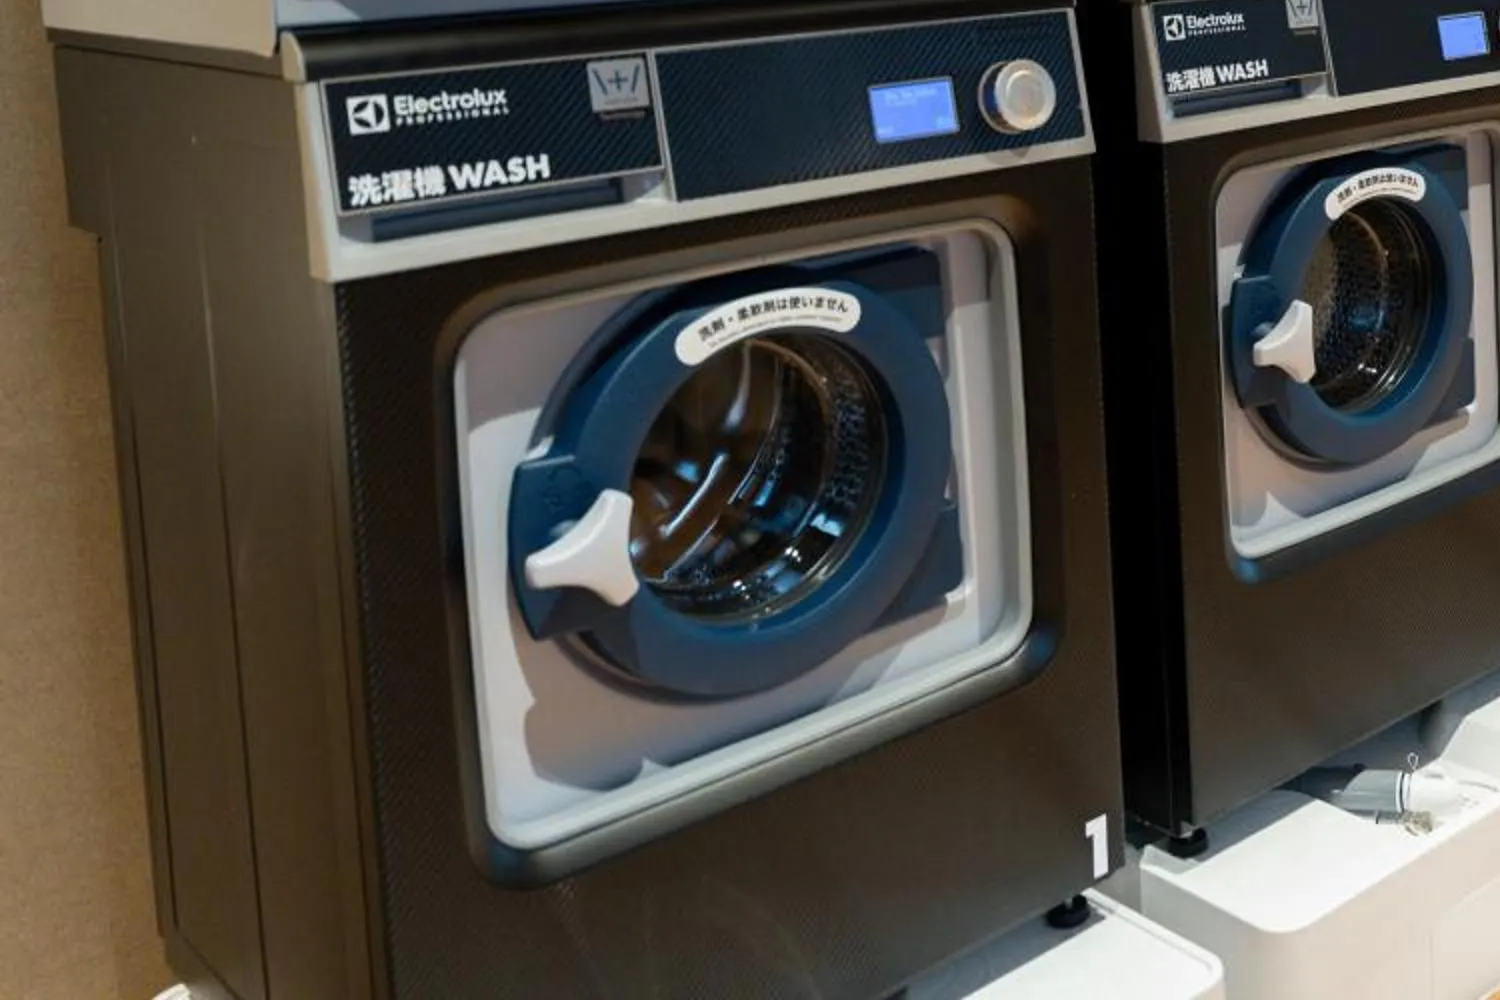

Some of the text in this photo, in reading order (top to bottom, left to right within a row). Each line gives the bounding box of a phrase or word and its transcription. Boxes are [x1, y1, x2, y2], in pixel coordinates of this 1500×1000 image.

[1186, 11, 1245, 29] Electrolux
[1216, 58, 1269, 83] WASH
[394, 88, 507, 116] Electrolux
[396, 106, 510, 126] PROFESSIONAL
[348, 152, 550, 207] 洗濯機 WASH
[1085, 812, 1109, 879] 1
